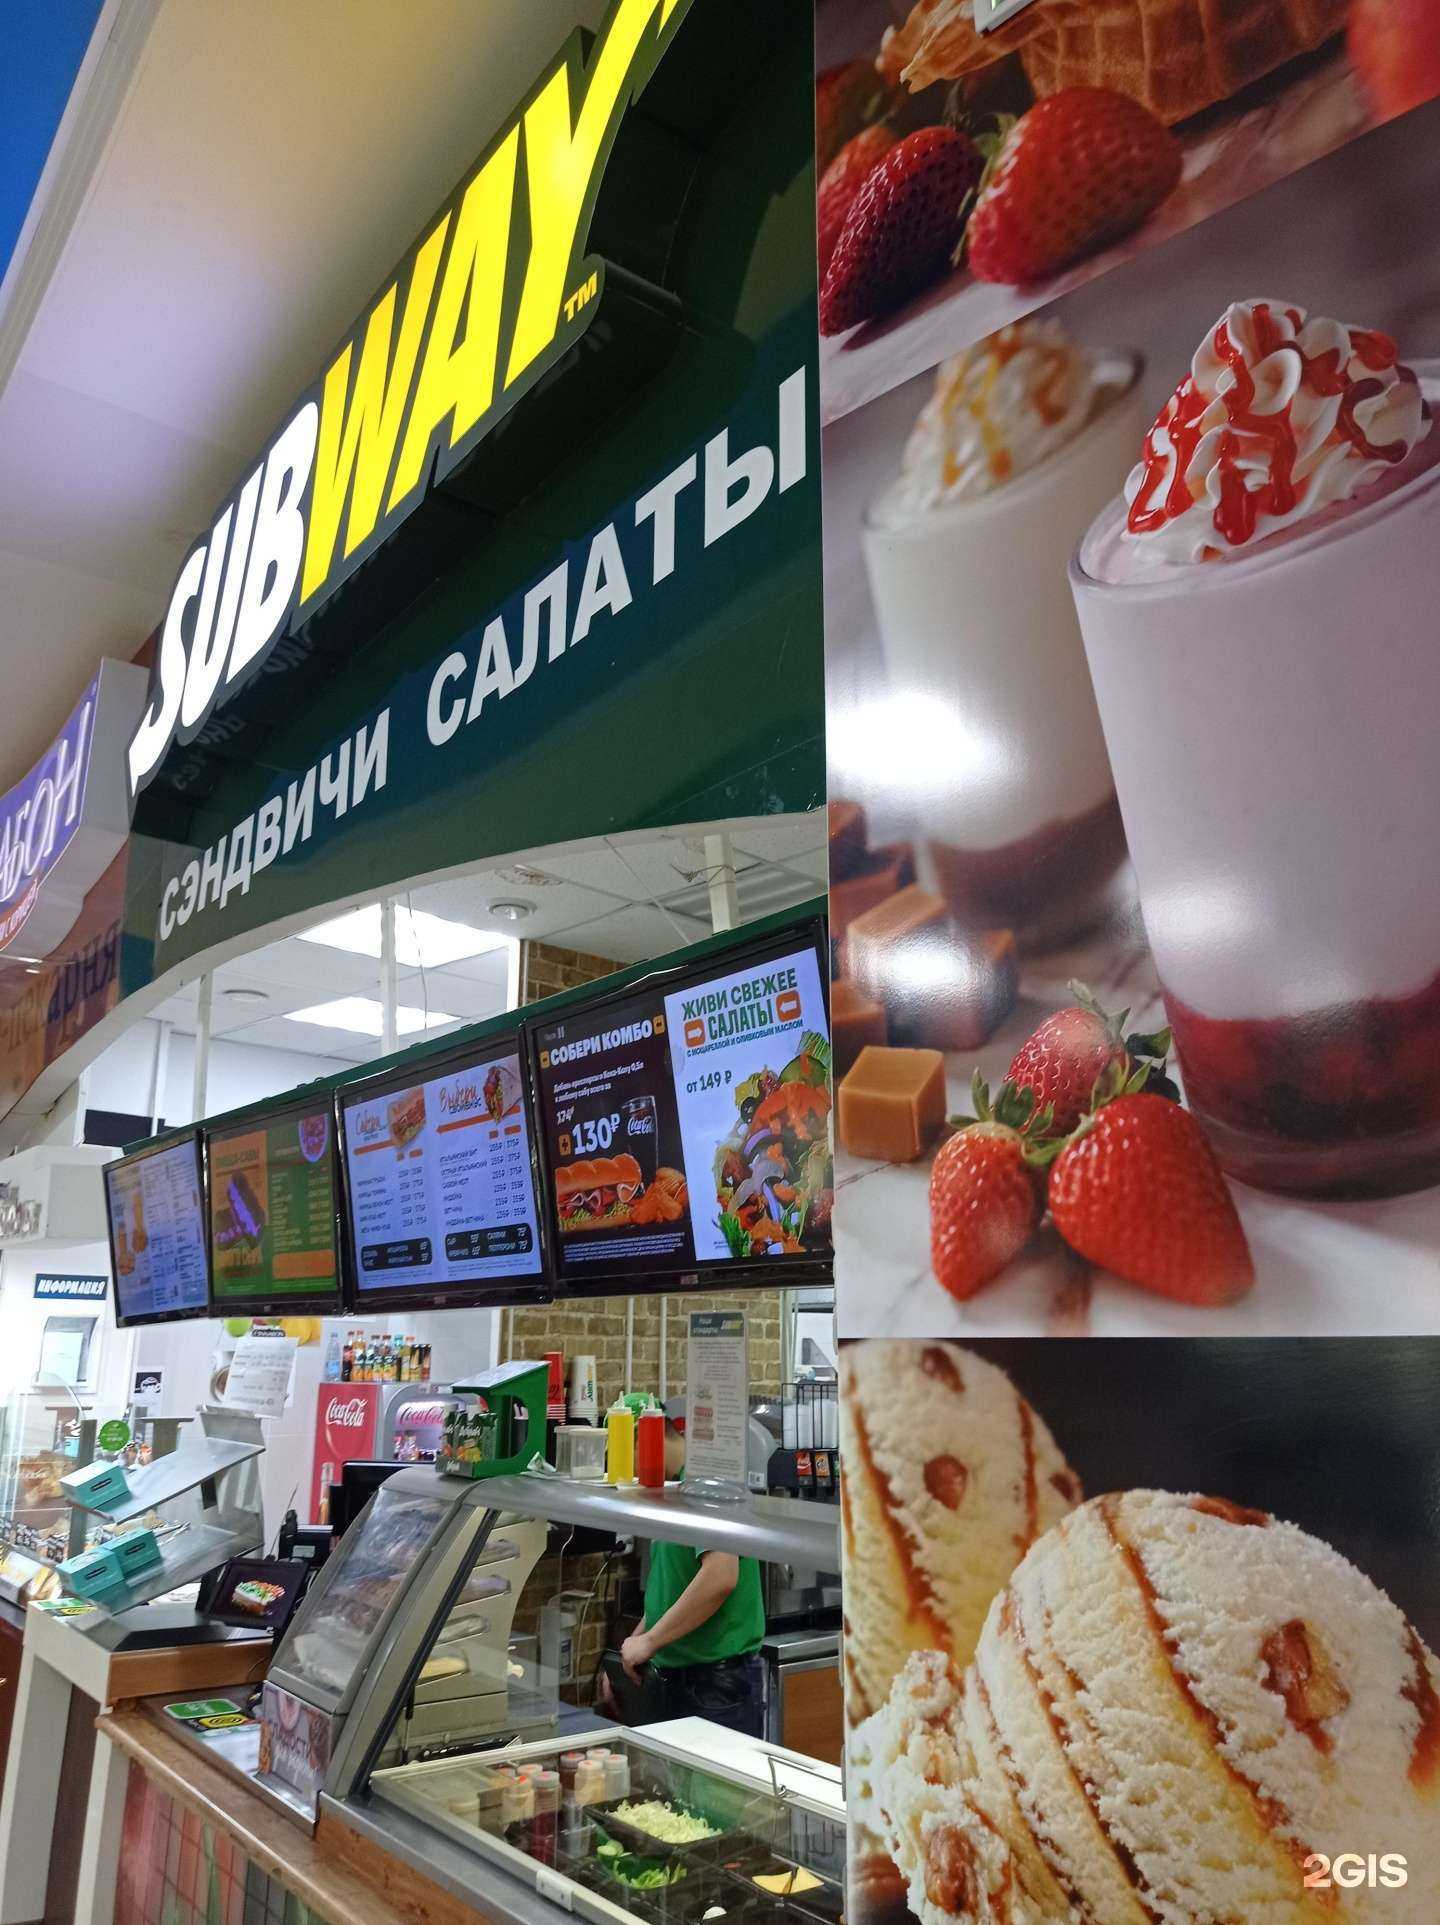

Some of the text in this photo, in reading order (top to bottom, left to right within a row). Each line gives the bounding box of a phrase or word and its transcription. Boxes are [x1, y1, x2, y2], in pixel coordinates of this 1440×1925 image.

[564, 270, 598, 322] TM
[129, 0, 692, 796] SUBWAY
[160, 365, 806, 942] СЭНДВИЧИ САЛАТЫ
[682, 968, 798, 1021] ЖИВИ СВЕЖЕЕ
[550, 1034, 602, 1067] СОБЕРИ
[602, 1019, 654, 1051] КОМБО
[707, 1000, 775, 1041] САЛАТЫ
[700, 1071, 721, 1092] 149
[37, 1278, 106, 1296] ИНФОРМАЦИЯ
